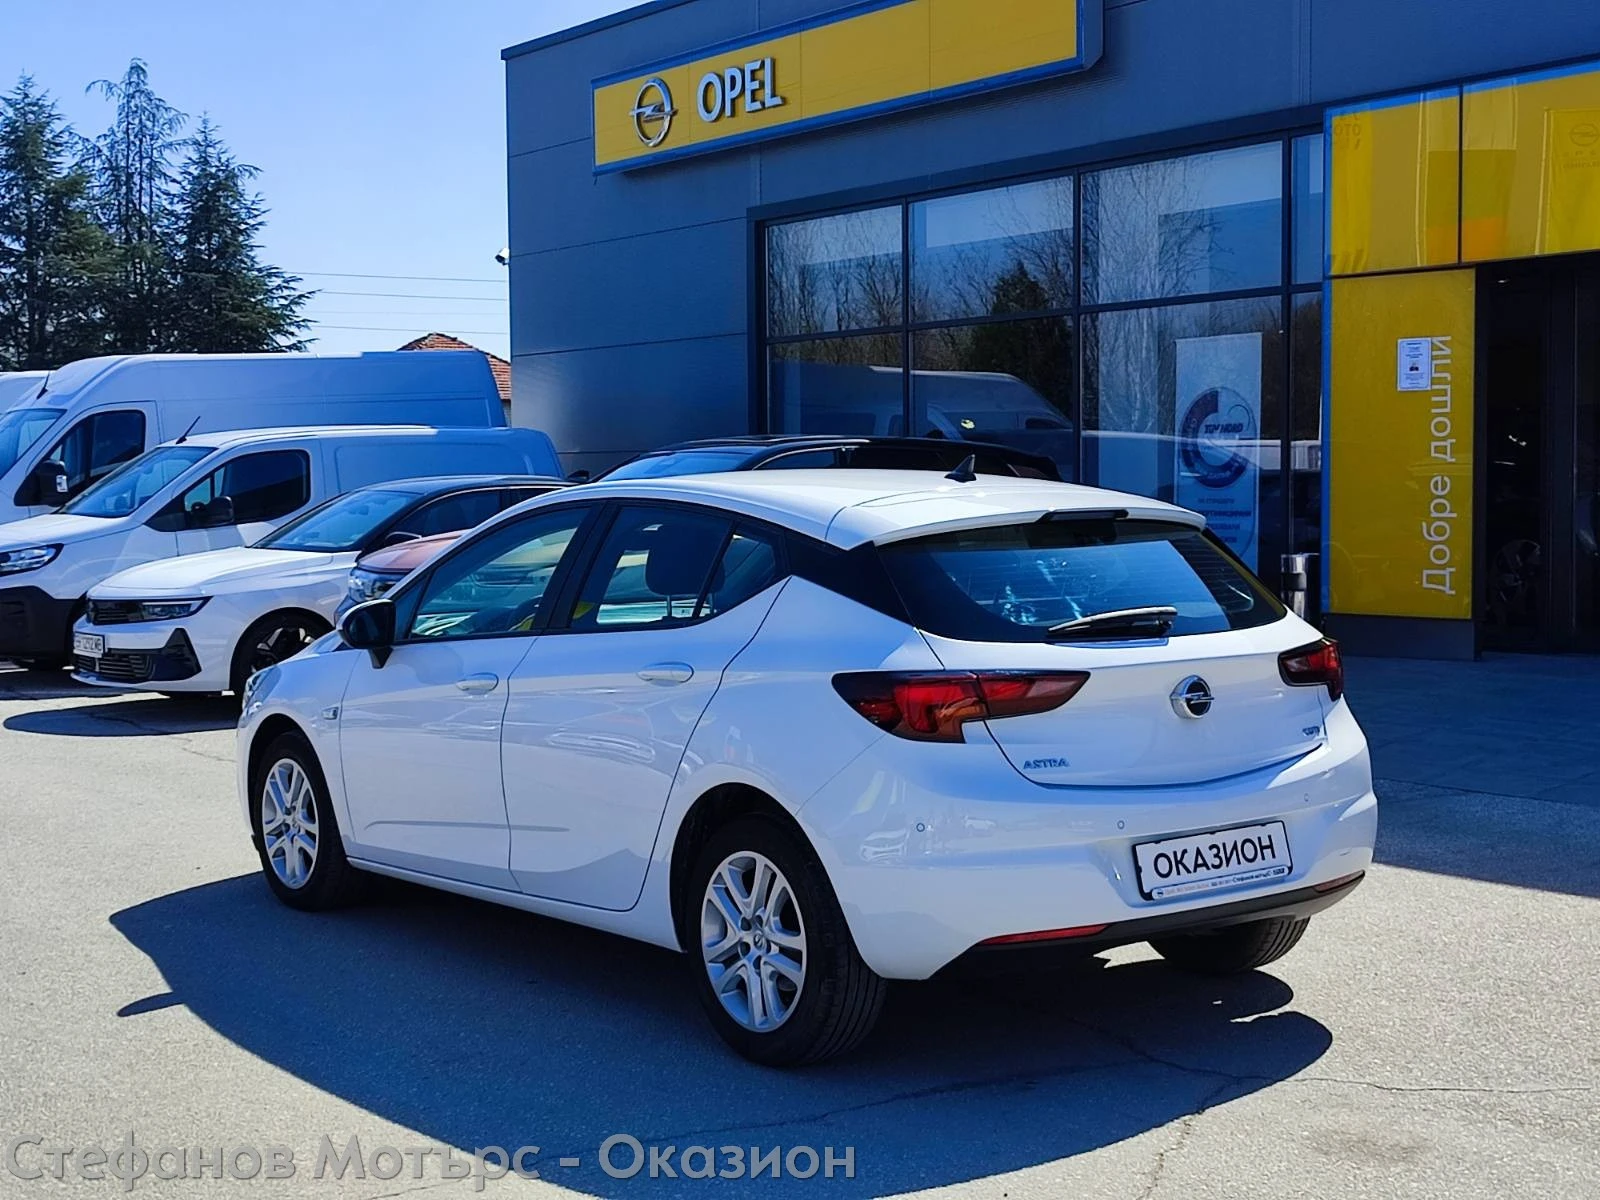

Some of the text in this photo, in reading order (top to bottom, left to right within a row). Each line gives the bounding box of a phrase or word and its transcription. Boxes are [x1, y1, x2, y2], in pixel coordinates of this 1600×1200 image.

[697, 57, 784, 123] OPEL
[1423, 335, 1457, 595] Добре дошли
[1023, 758, 1070, 769] ASTRA
[1153, 834, 1277, 879] ОКАЗИОН
